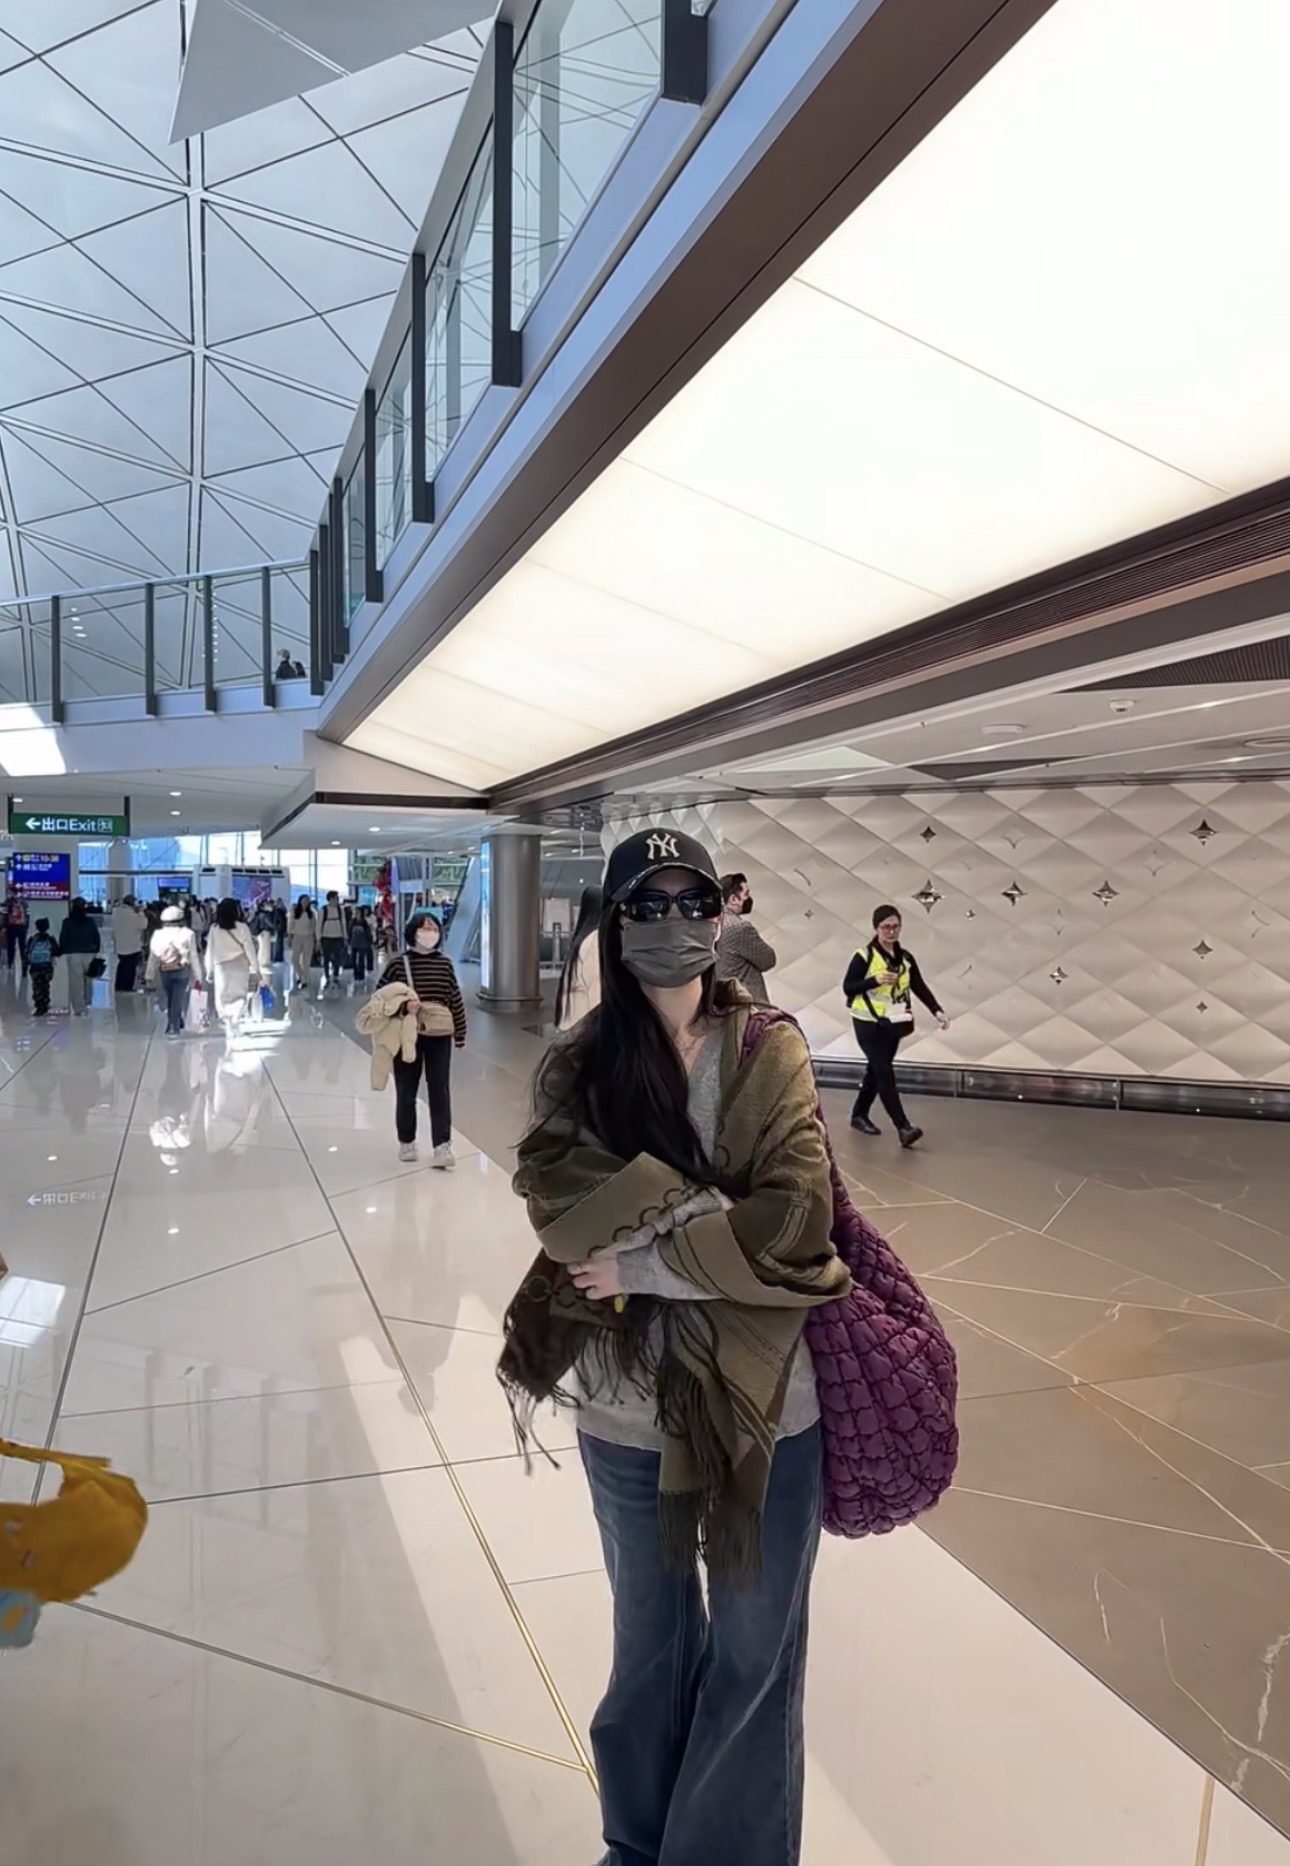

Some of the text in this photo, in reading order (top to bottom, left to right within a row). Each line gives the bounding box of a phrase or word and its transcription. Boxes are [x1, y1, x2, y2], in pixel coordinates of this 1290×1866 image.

[42, 817, 97, 832] 出口 Exit
[645, 832, 681, 861] NY
